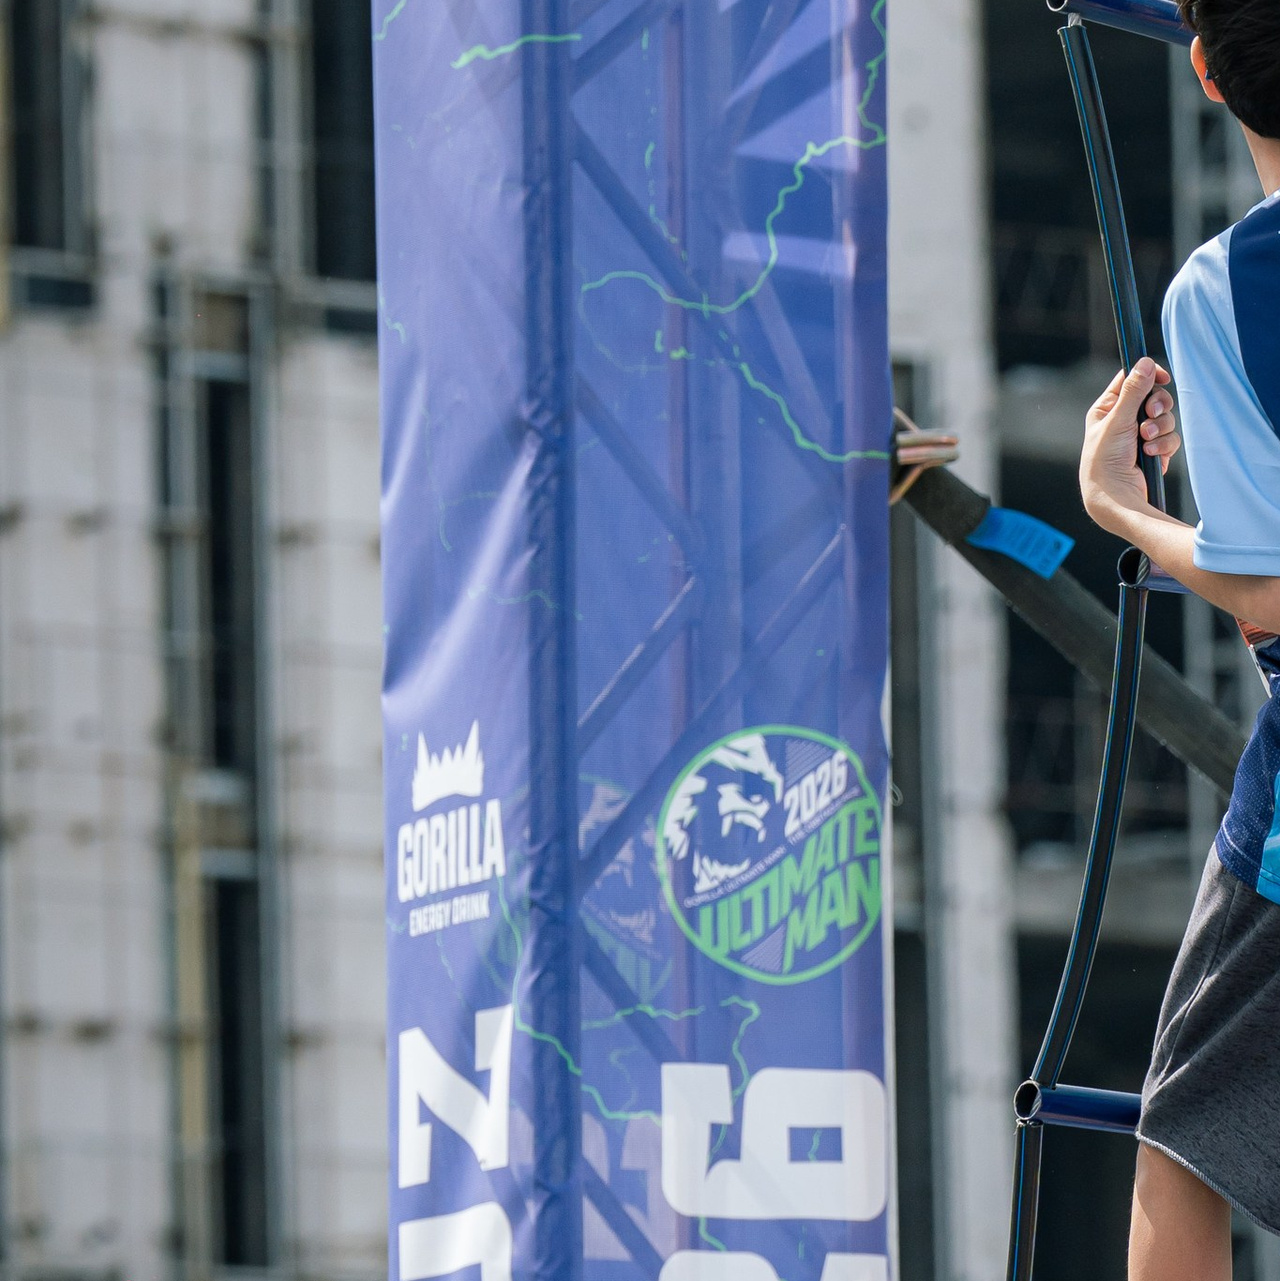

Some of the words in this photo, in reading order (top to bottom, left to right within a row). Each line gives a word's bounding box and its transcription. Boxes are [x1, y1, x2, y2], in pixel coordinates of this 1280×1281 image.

[784, 749, 848, 838] 2026
[397, 798, 506, 903] GORILLA
[699, 795, 880, 959] ULTIMATE
[409, 899, 452, 937] ENERGY
[452, 890, 491, 926] DRINK
[782, 857, 880, 975] MAN
